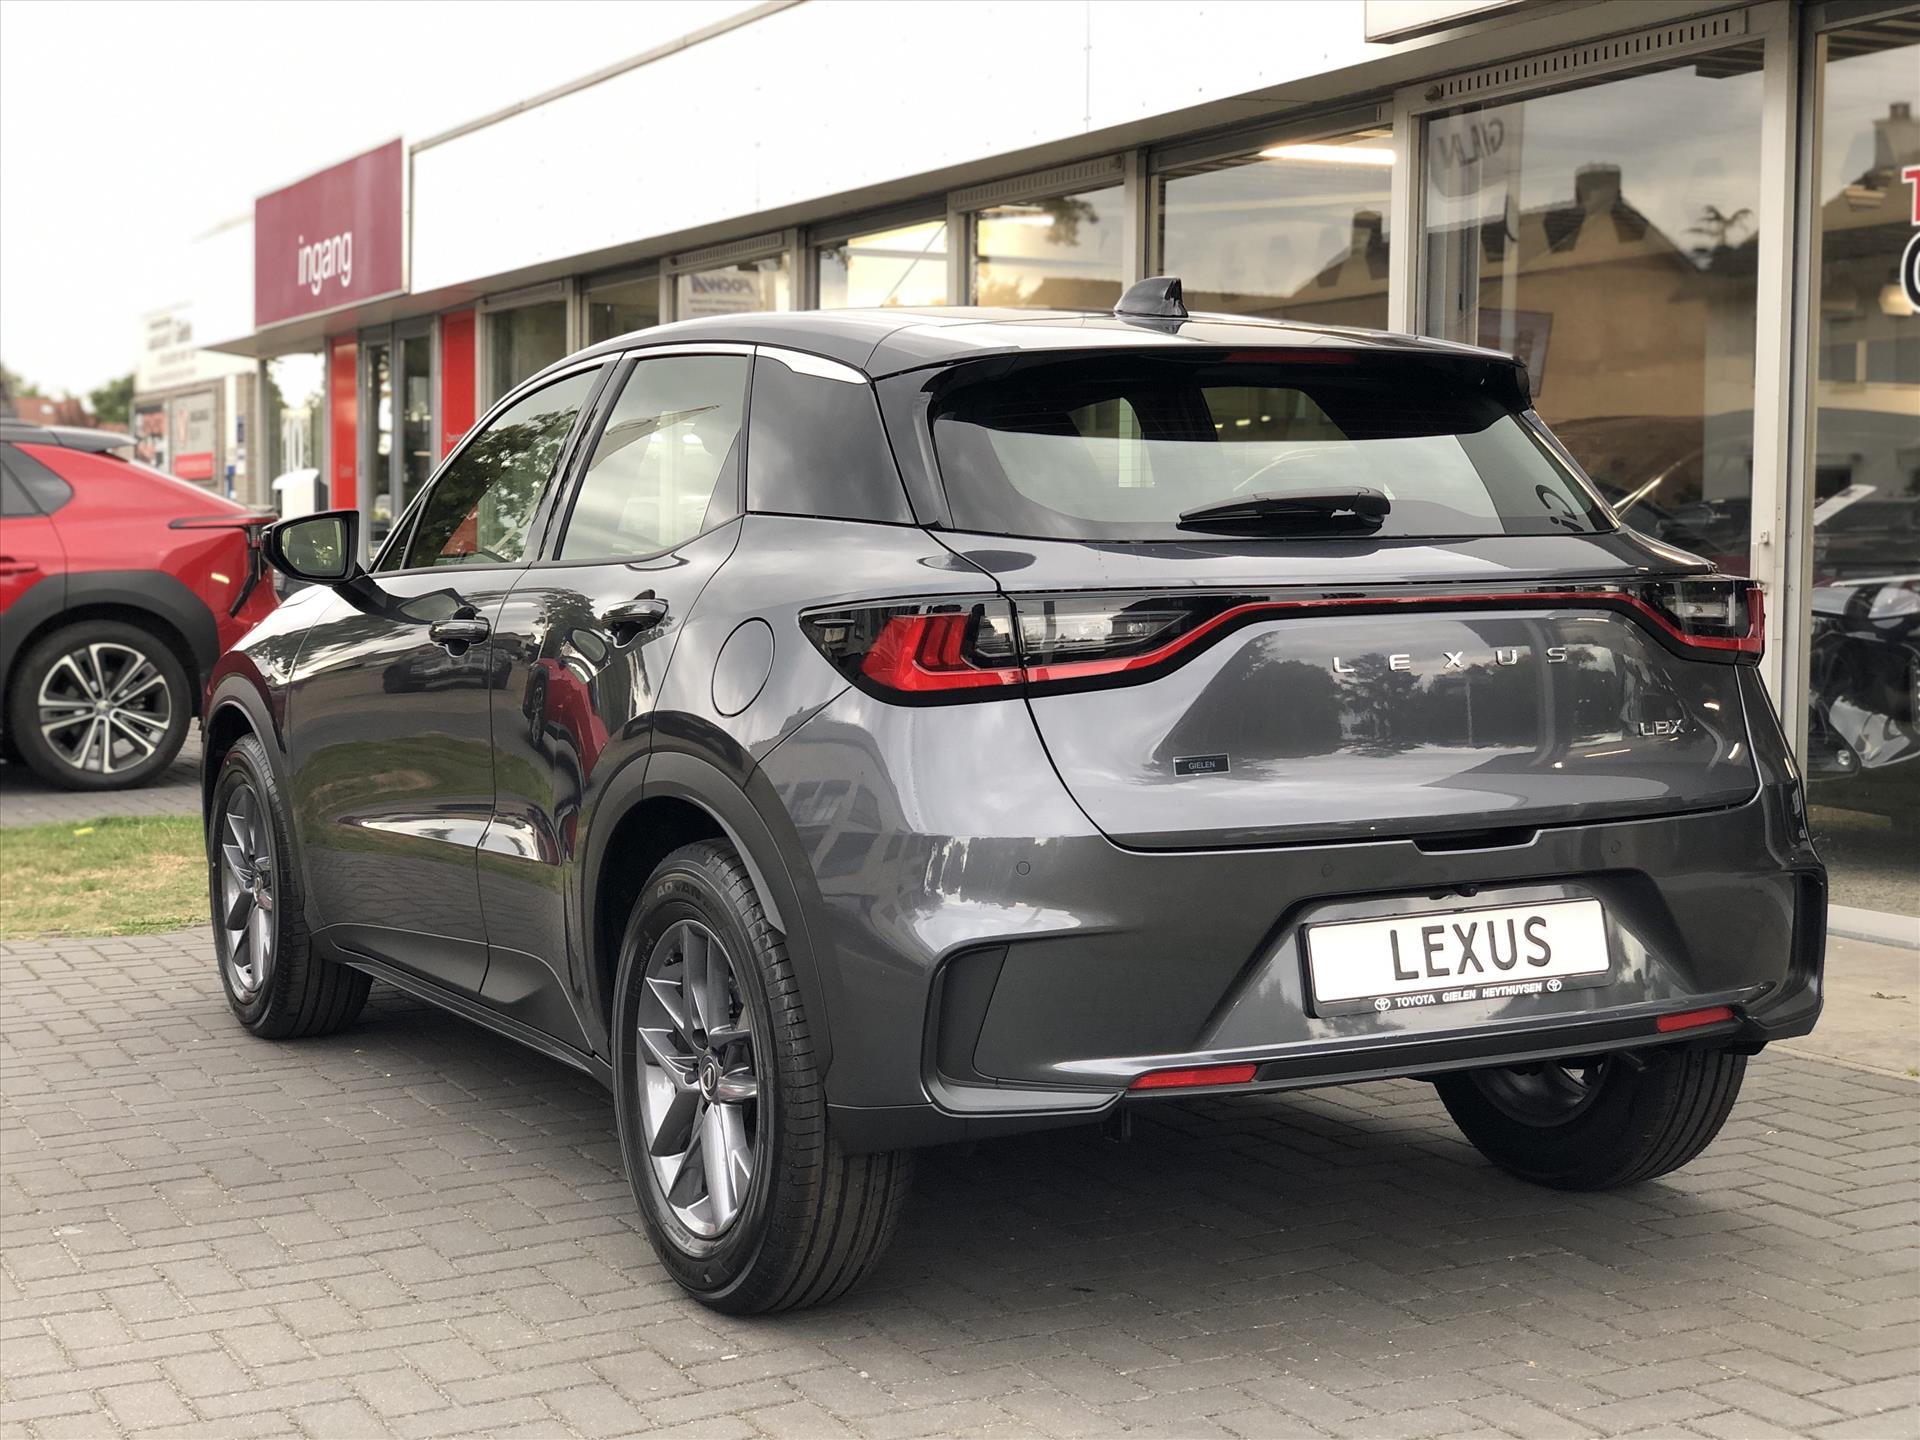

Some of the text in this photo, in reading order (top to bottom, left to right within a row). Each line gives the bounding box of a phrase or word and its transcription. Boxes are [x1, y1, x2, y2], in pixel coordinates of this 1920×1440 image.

[297, 231, 352, 296] ingang
[1333, 647, 1568, 673] LEXUS
[1639, 719, 1685, 736] LBX
[1188, 760, 1216, 770] GIELEN
[1390, 916, 1552, 981] LEXUS
[1396, 982, 1543, 1008] TOYOTA GIELEN HEYTHUYSEN
